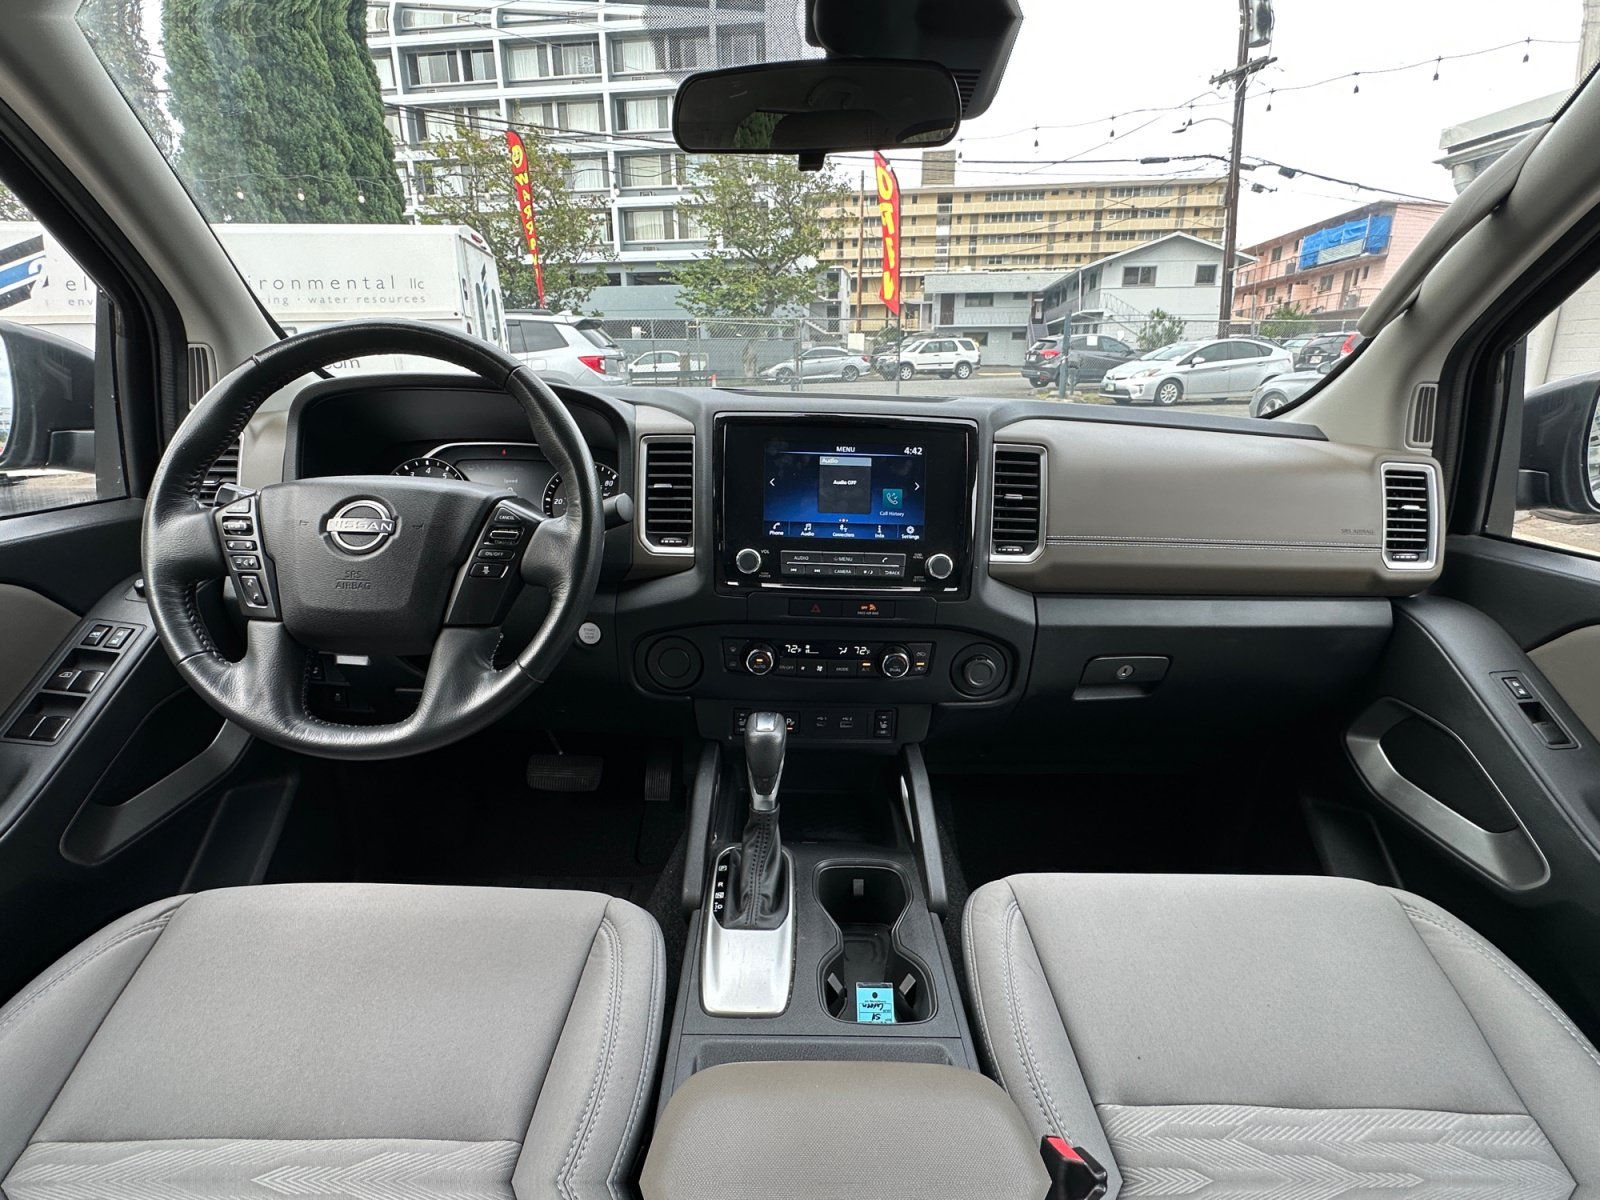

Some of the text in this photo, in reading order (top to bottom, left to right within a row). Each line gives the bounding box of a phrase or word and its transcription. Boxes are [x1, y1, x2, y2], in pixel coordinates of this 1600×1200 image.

[307, 295, 348, 304] water
[356, 294, 426, 304] resources
[903, 446, 923, 455] 4:42
[425, 466, 431, 474] 4
[442, 472, 448, 480] 5
[889, 510, 905, 518] History
[328, 520, 393, 532] NISSAN
[901, 533, 920, 541] Settings
[335, 581, 371, 590] AIRBAG
